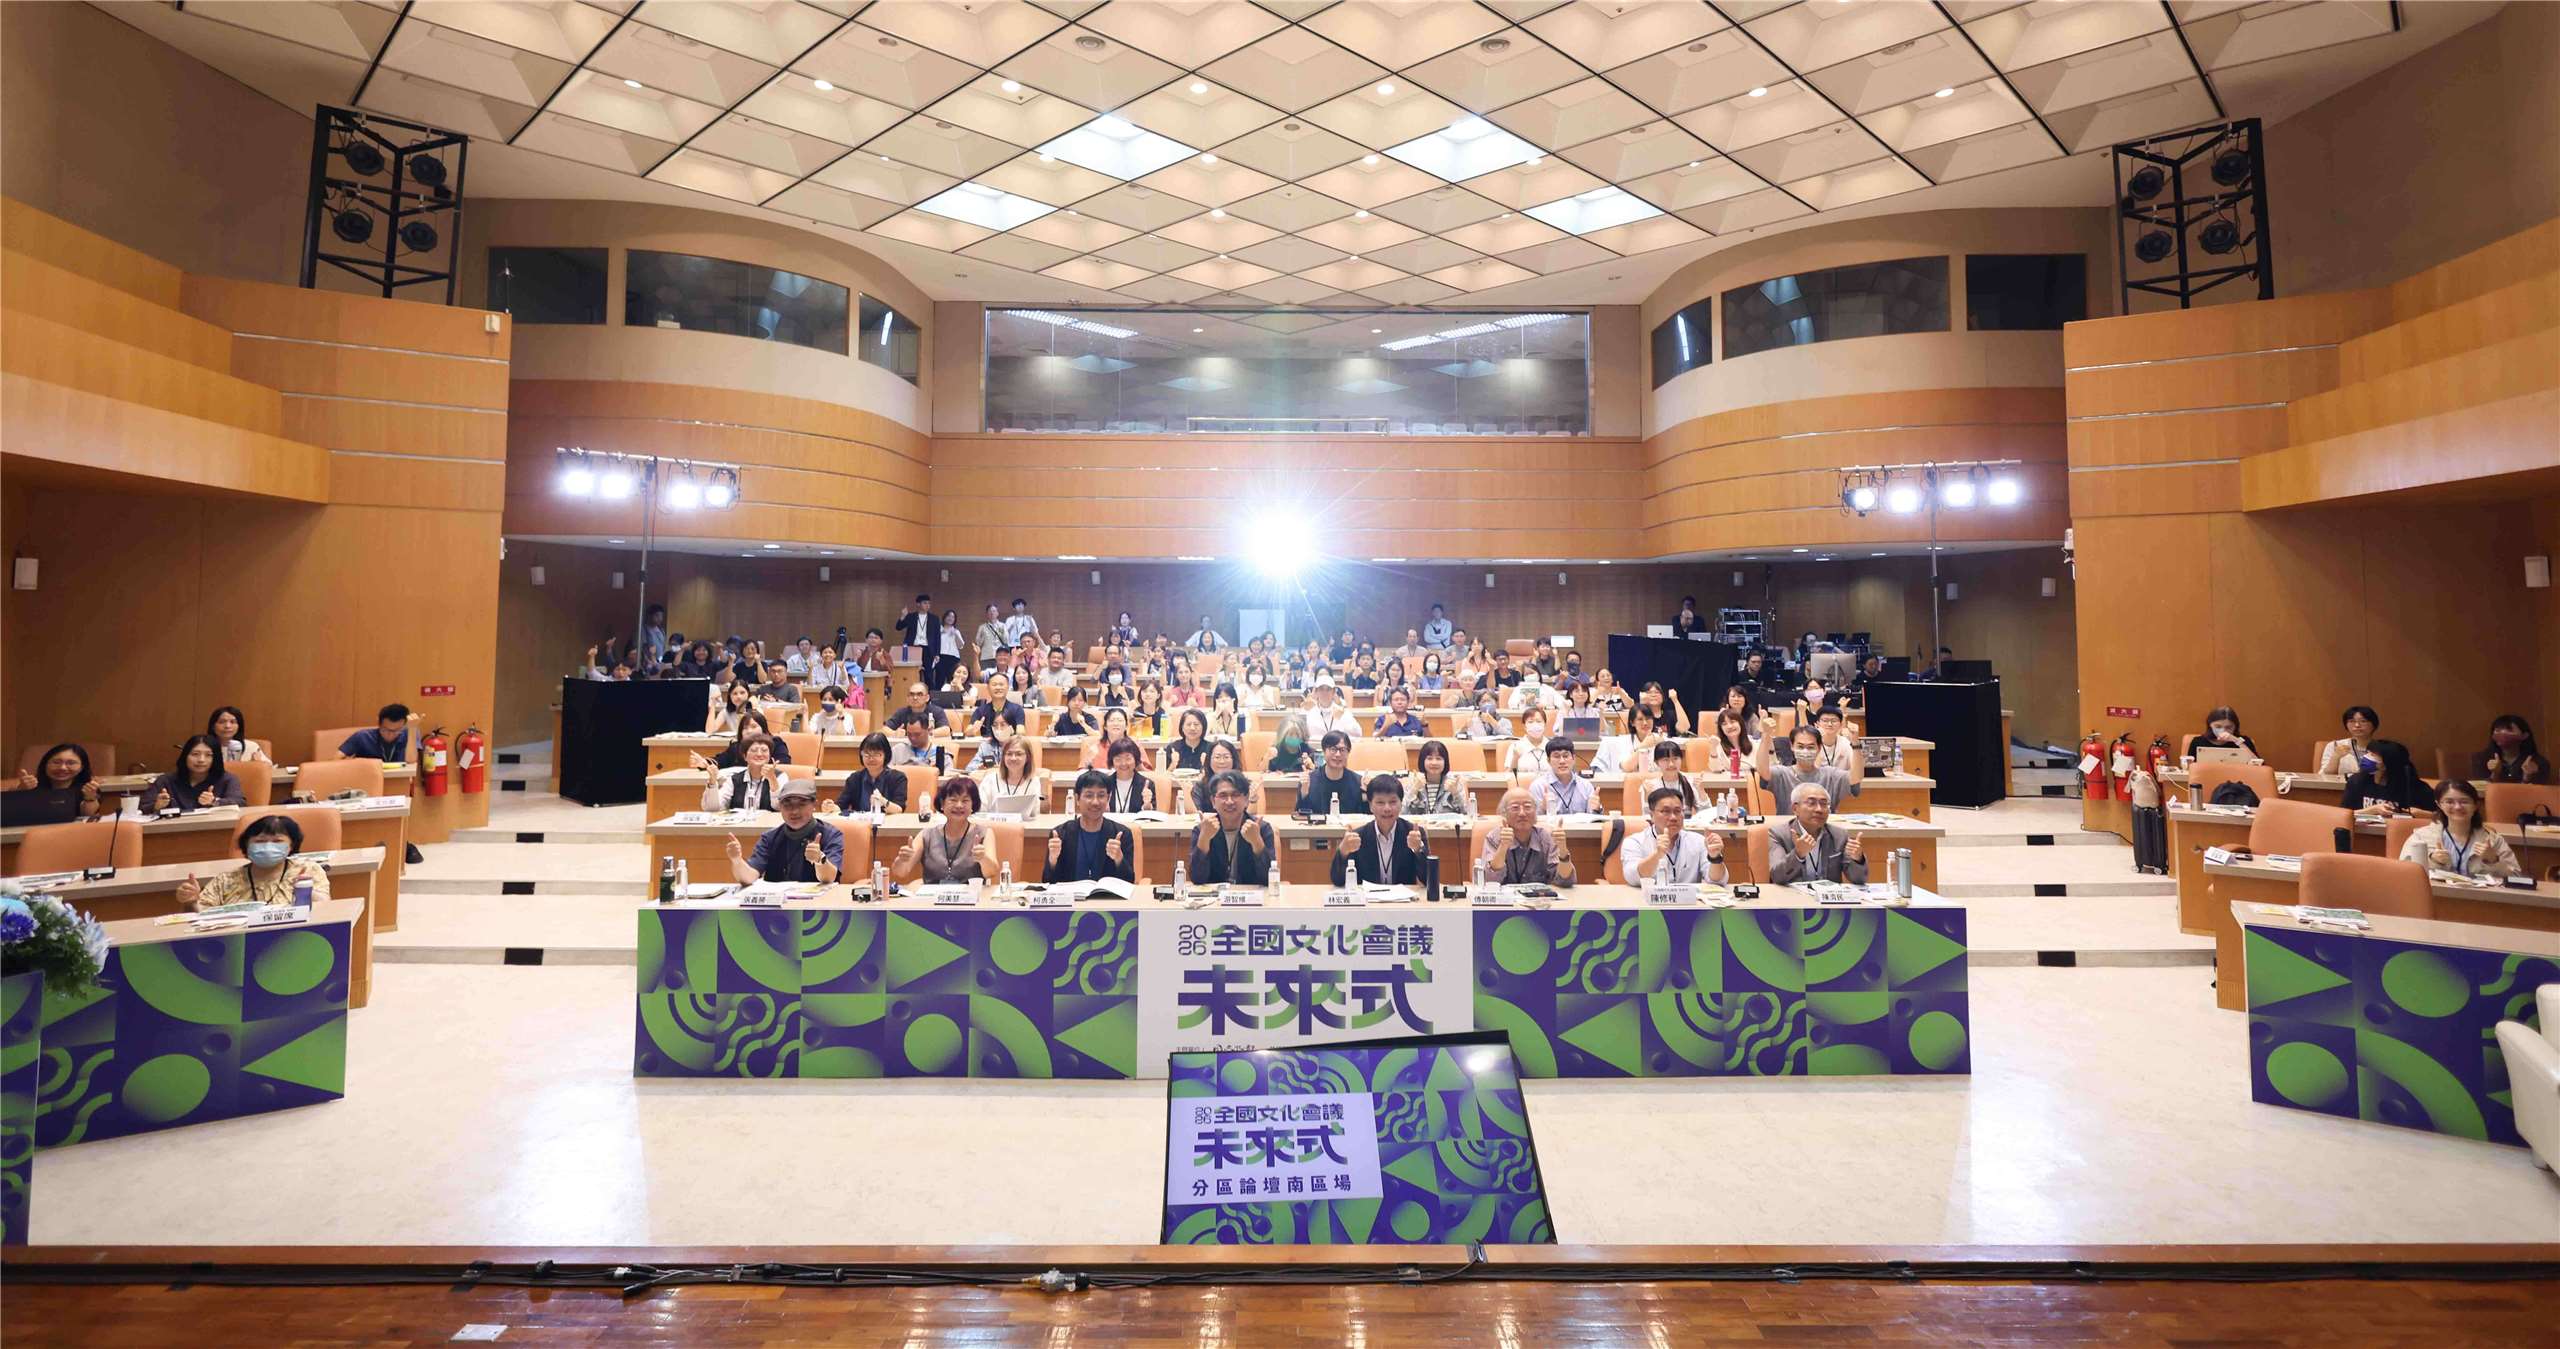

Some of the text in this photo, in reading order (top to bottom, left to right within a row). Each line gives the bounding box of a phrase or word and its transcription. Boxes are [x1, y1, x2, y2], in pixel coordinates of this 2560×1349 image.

[1211, 924, 1433, 956] 全國文化會議
[1177, 958, 1434, 1036] 未來式
[1214, 1103, 1344, 1124] 全國文化會議
[1193, 1122, 1348, 1169] 未來式
[1192, 1174, 1352, 1197] 分區論壇南區場
